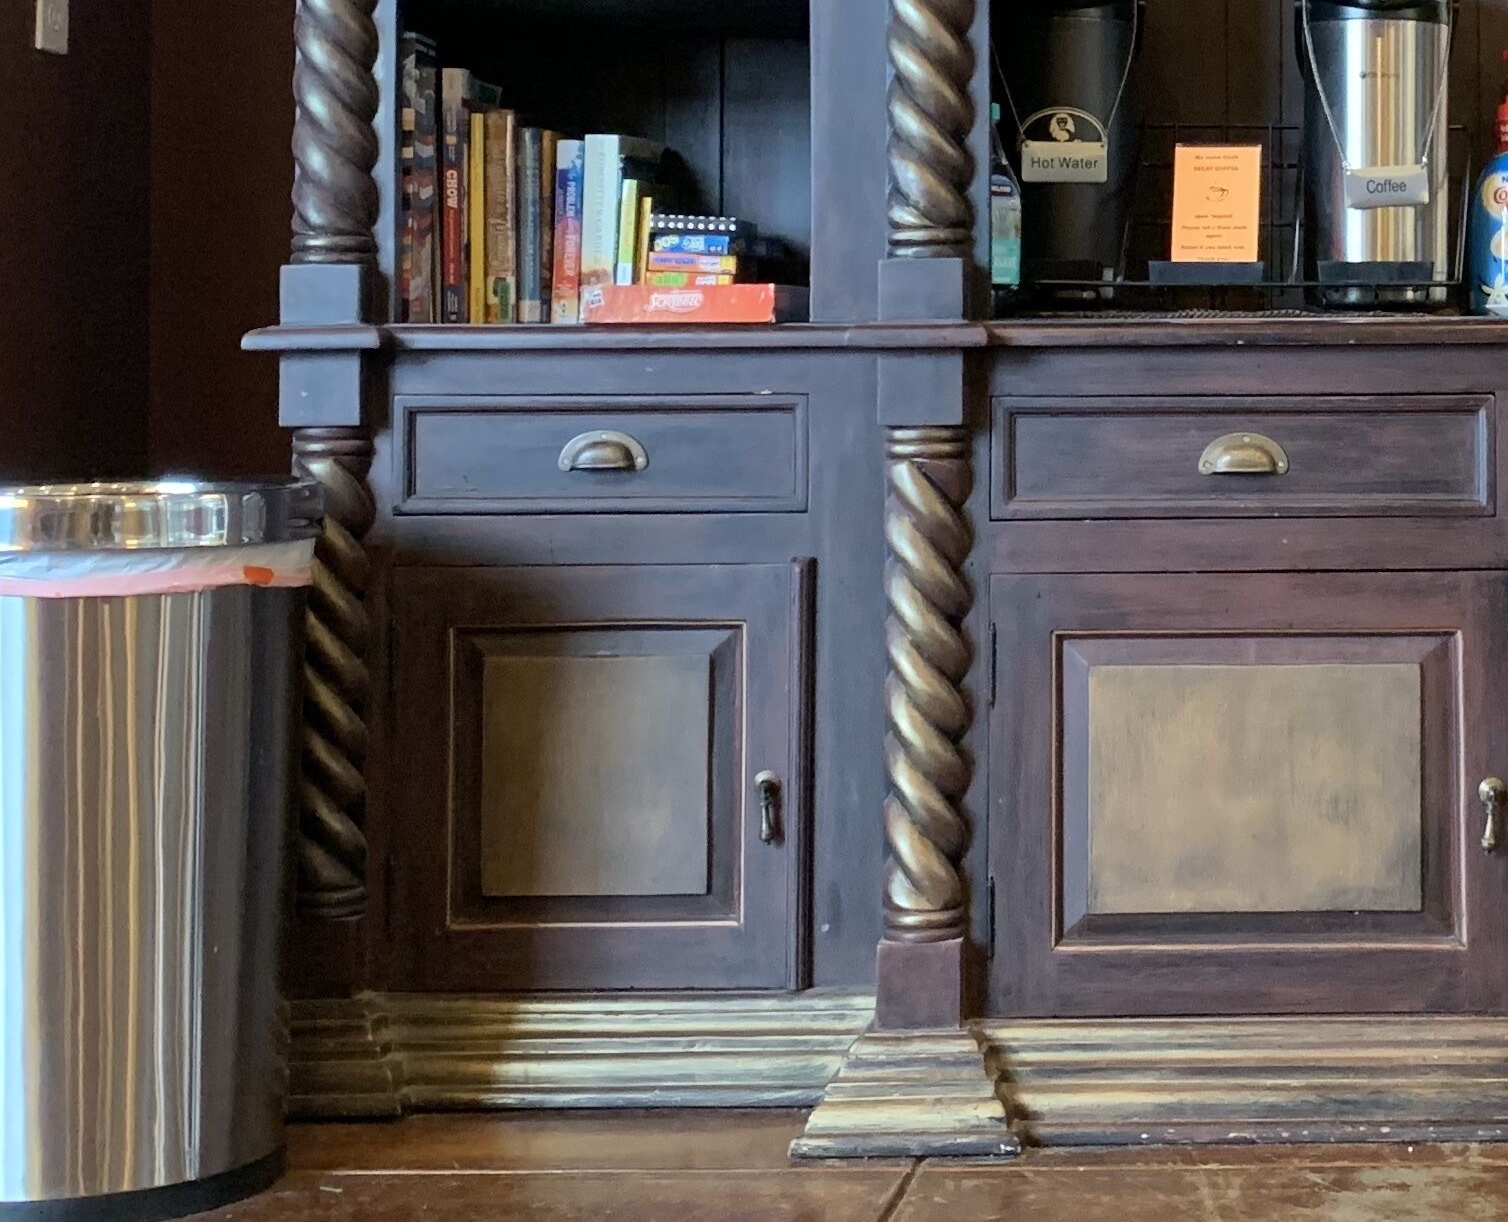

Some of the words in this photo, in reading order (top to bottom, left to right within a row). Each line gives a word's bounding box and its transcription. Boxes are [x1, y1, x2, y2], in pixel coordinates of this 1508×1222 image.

[1031, 157, 1054, 169] Hot
[1058, 157, 1098, 169] Water
[446, 170, 458, 209] CHOW
[1366, 178, 1407, 195] Coffee
